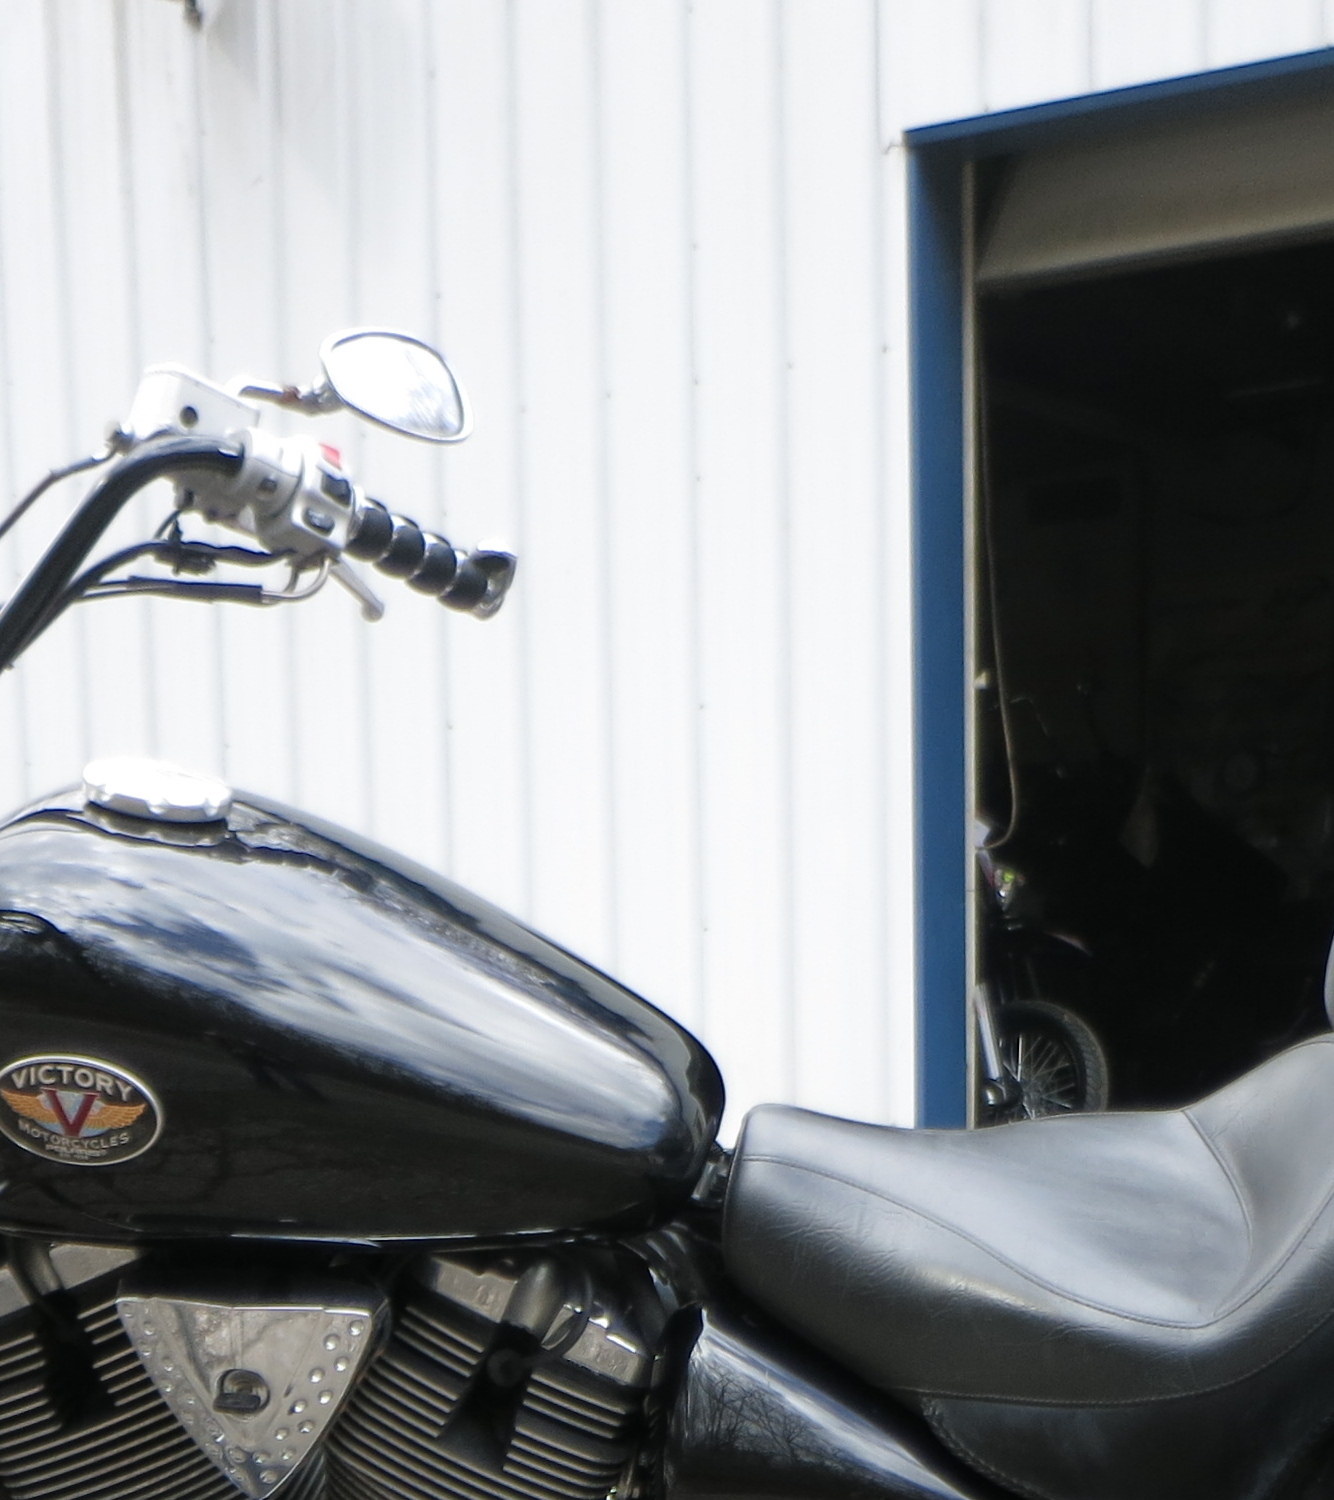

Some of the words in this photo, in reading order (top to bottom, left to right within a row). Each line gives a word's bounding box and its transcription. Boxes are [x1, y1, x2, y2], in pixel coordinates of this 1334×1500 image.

[11, 1065, 134, 1102] VICTORY
[40, 1087, 101, 1138] V
[18, 1119, 130, 1149] MOTORCYCLES
